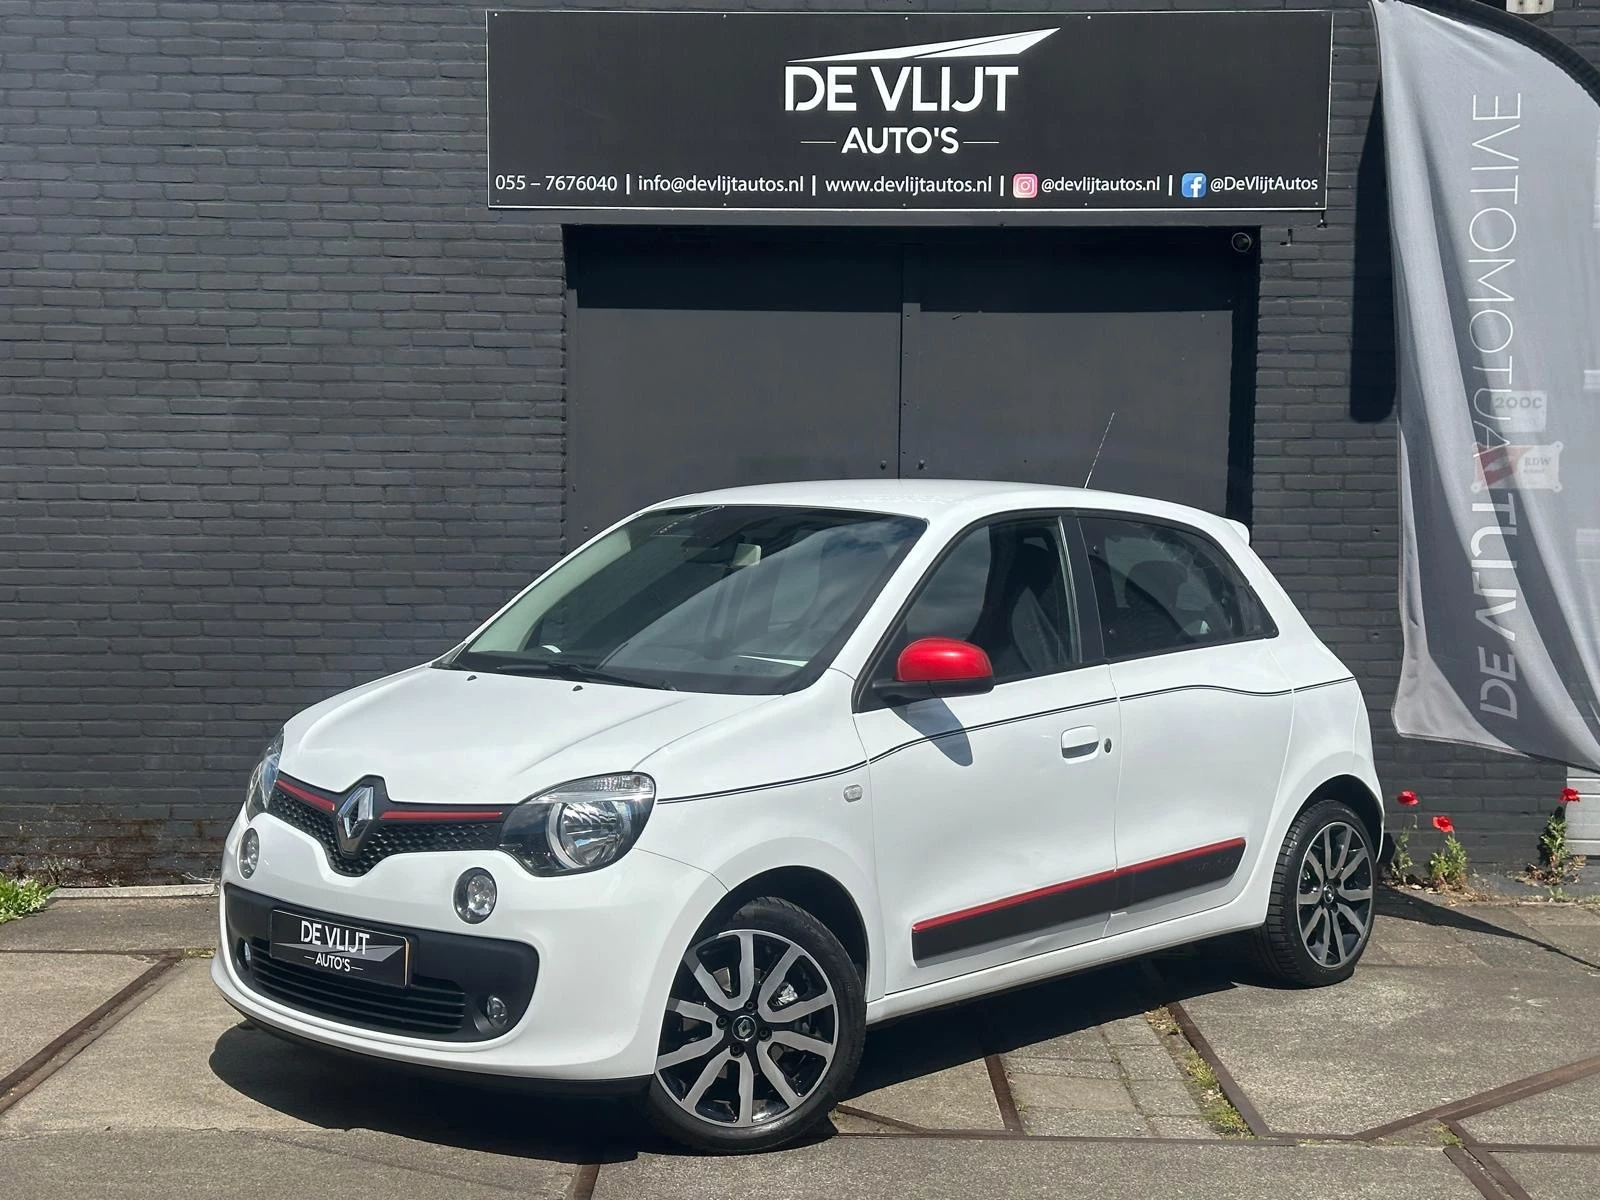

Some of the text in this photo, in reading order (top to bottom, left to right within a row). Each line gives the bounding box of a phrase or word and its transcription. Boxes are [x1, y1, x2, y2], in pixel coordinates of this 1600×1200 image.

[785, 66, 1019, 113] DE VLIJT
[840, 126, 960, 155] AUTO'S
[495, 174, 526, 191] 055
[545, 175, 618, 192] 7676040
[638, 174, 804, 196] info@devlijtautos.nl
[825, 175, 992, 197] www.devlijtautos.nl
[1041, 175, 1161, 196] @devlijtautos.nl
[1210, 175, 1319, 195] @DeVlijtAutos
[301, 920, 370, 956] DE VLIJT
[315, 952, 351, 972] AUTO'S
